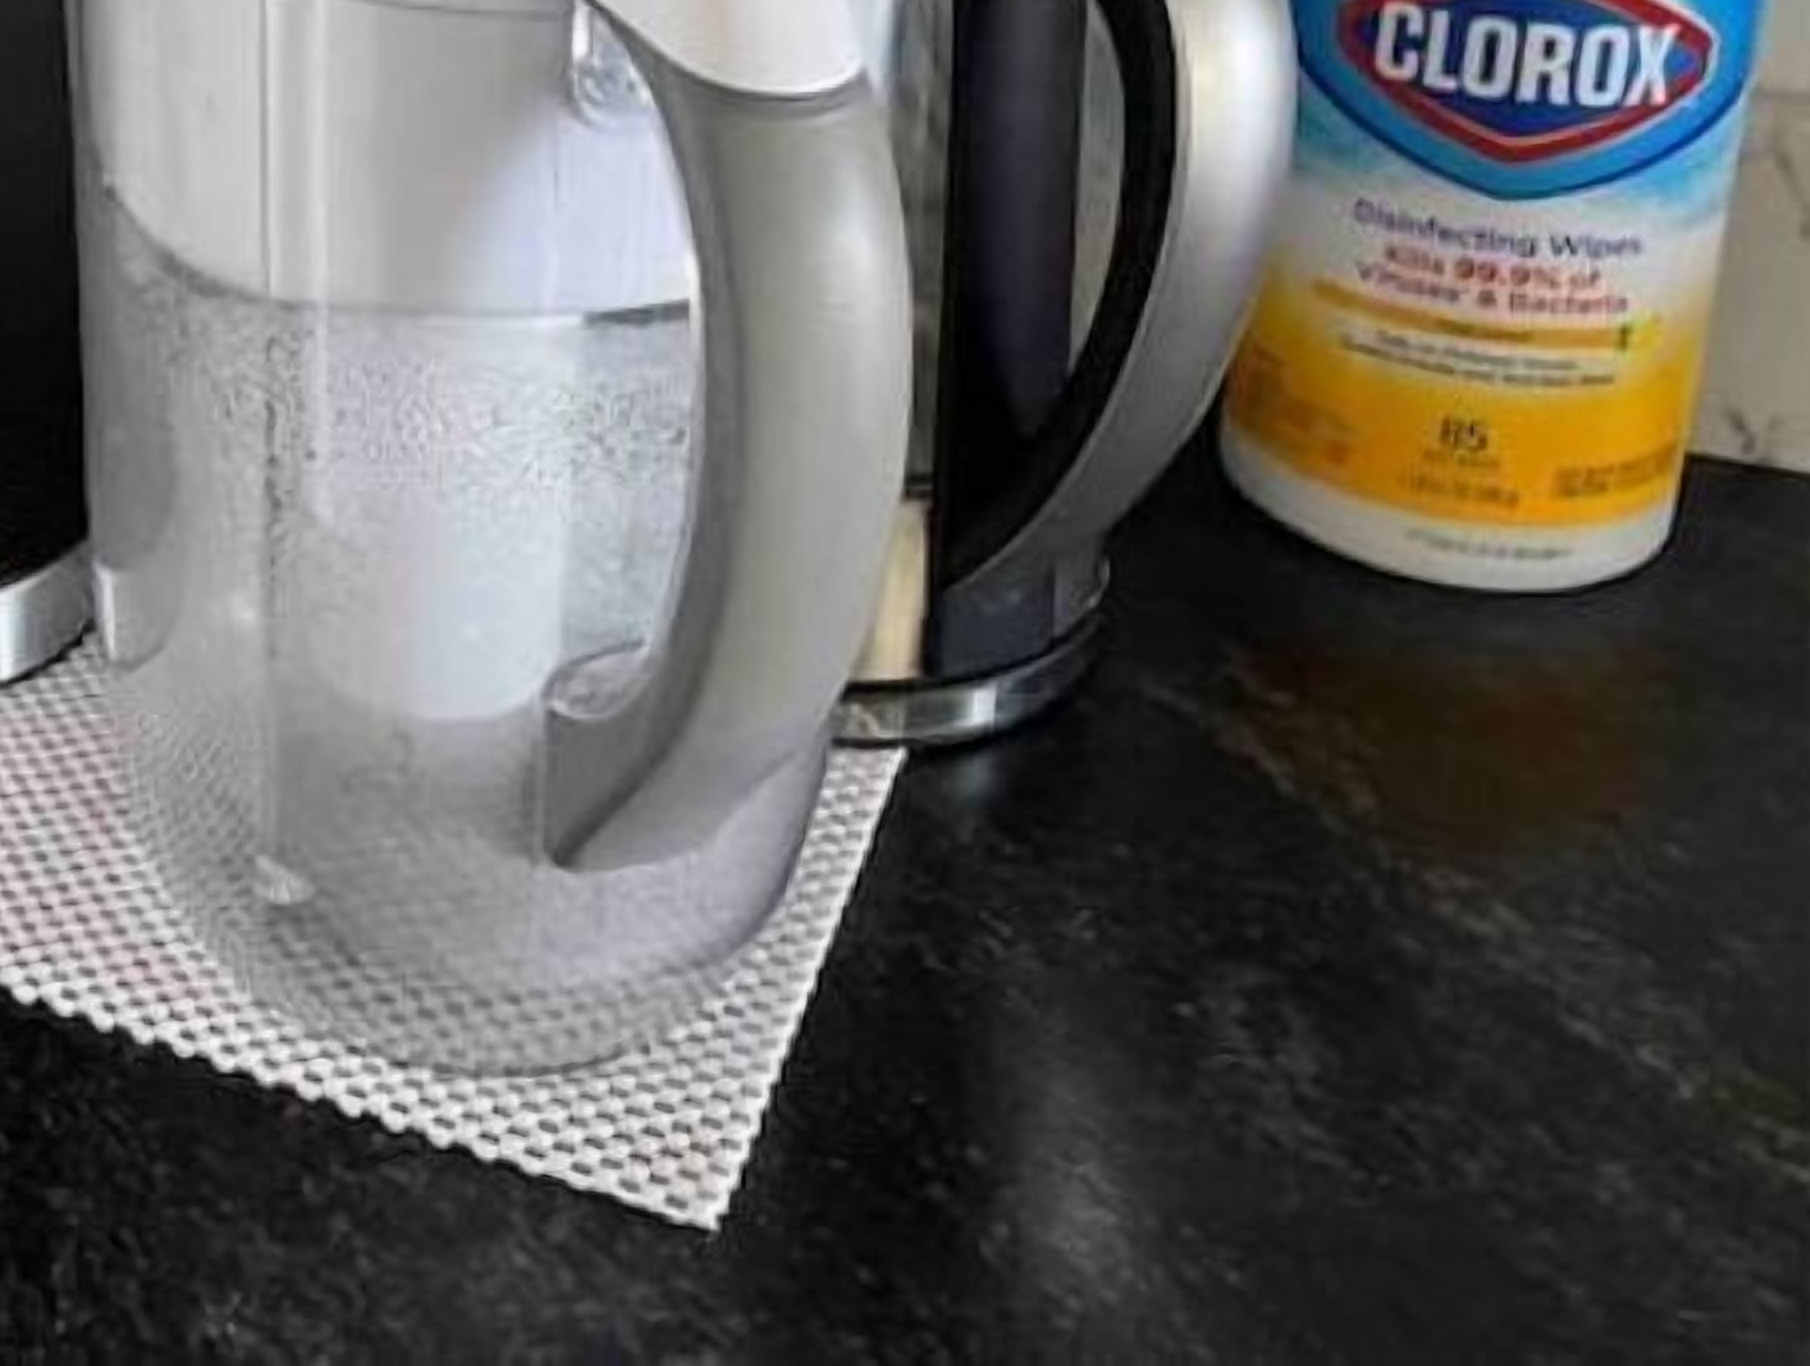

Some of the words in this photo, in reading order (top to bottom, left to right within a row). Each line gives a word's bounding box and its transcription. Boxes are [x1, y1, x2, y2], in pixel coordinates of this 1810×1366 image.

[1374, 0, 1679, 107] CLOROX
[1352, 197, 1538, 260] Disinfecting
[1549, 232, 1642, 259] Wipes
